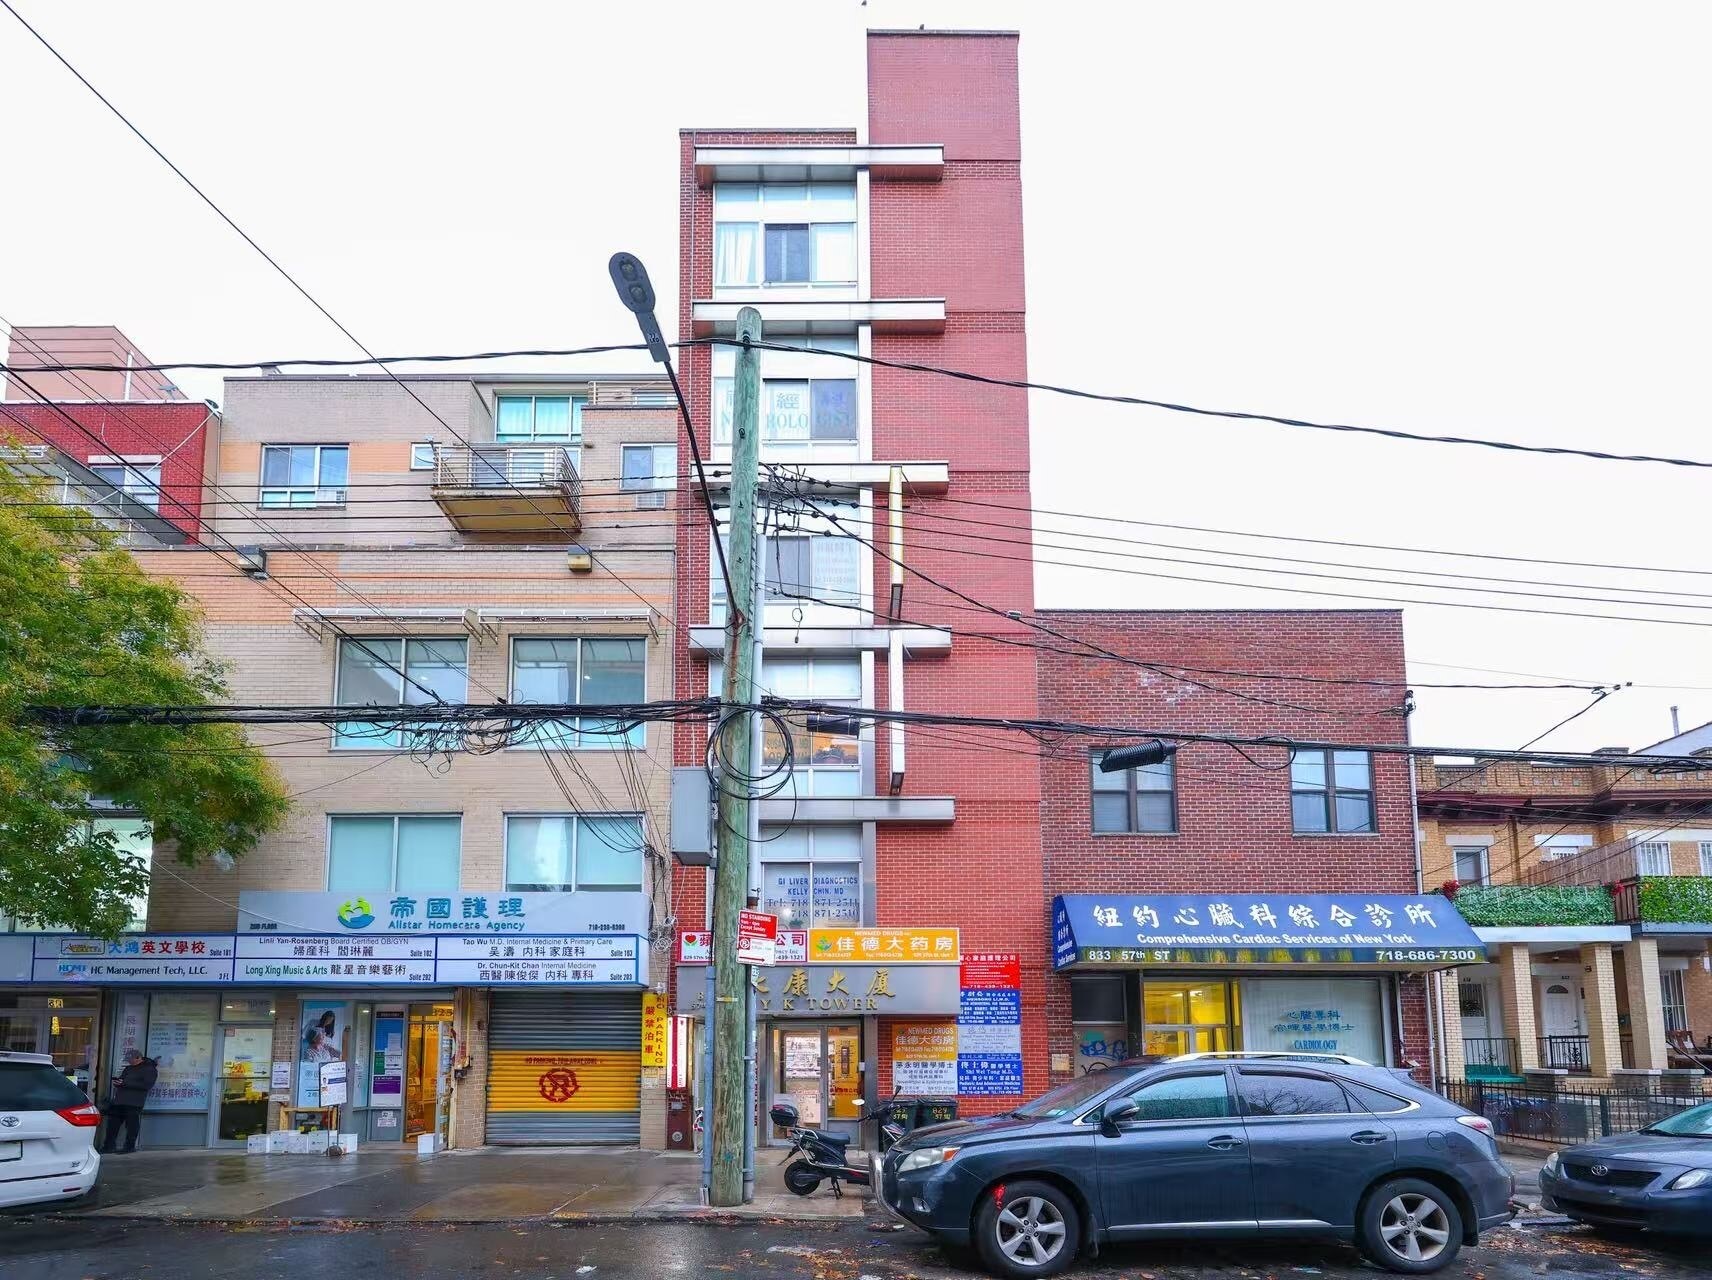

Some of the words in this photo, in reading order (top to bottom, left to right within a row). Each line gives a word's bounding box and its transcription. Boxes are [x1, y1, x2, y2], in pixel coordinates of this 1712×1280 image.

[814, 876, 858, 885] DIAGNOSTICS
[787, 888, 808, 896] KELLY
[390, 896, 526, 920] 帝國護理
[791, 899, 808, 907] 718
[749, 914, 772, 922] STANDING
[791, 910, 808, 918] 718
[1093, 903, 1437, 928] 紐約心臟科綜合診所
[388, 920, 422, 930] Allstar
[486, 921, 525, 932] Agency
[570, 939, 595, 947] Primary
[776, 934, 804, 946] 公司
[836, 936, 953, 951] 佳德大药房
[1137, 934, 1232, 945] Comprehensive
[1233, 934, 1281, 944] Cardiac
[1282, 934, 1337, 944] Services
[1340, 934, 1352, 944] of
[1354, 934, 1382, 944] New
[1383, 934, 1416, 944] York
[108, 940, 206, 954] 大鴻英文學校
[550, 946, 585, 957] 家庭科
[1089, 950, 1111, 960] 833
[1121, 950, 1145, 960] 57th
[1154, 950, 1170, 960] ST
[1376, 950, 1476, 960] 718-686-7300
[91, 966, 104, 974] HC
[106, 966, 160, 976] Management
[164, 966, 185, 976] Tech,
[189, 966, 208, 975] LLC.
[245, 965, 264, 976] Long
[265, 965, 281, 976] Xing
[282, 965, 304, 975] Music
[306, 966, 312, 975] &
[312, 965, 328, 975] Arts
[330, 964, 406, 976] 龍星音樂藝術
[760, 998, 770, 1010] Y
[784, 998, 795, 1010] K
[807, 998, 880, 1010] TOWER
[655, 1016, 664, 1063] PARKING
[896, 1035, 954, 1045] 佳德大药房
[1294, 1040, 1338, 1050] CARDIOLOGY
